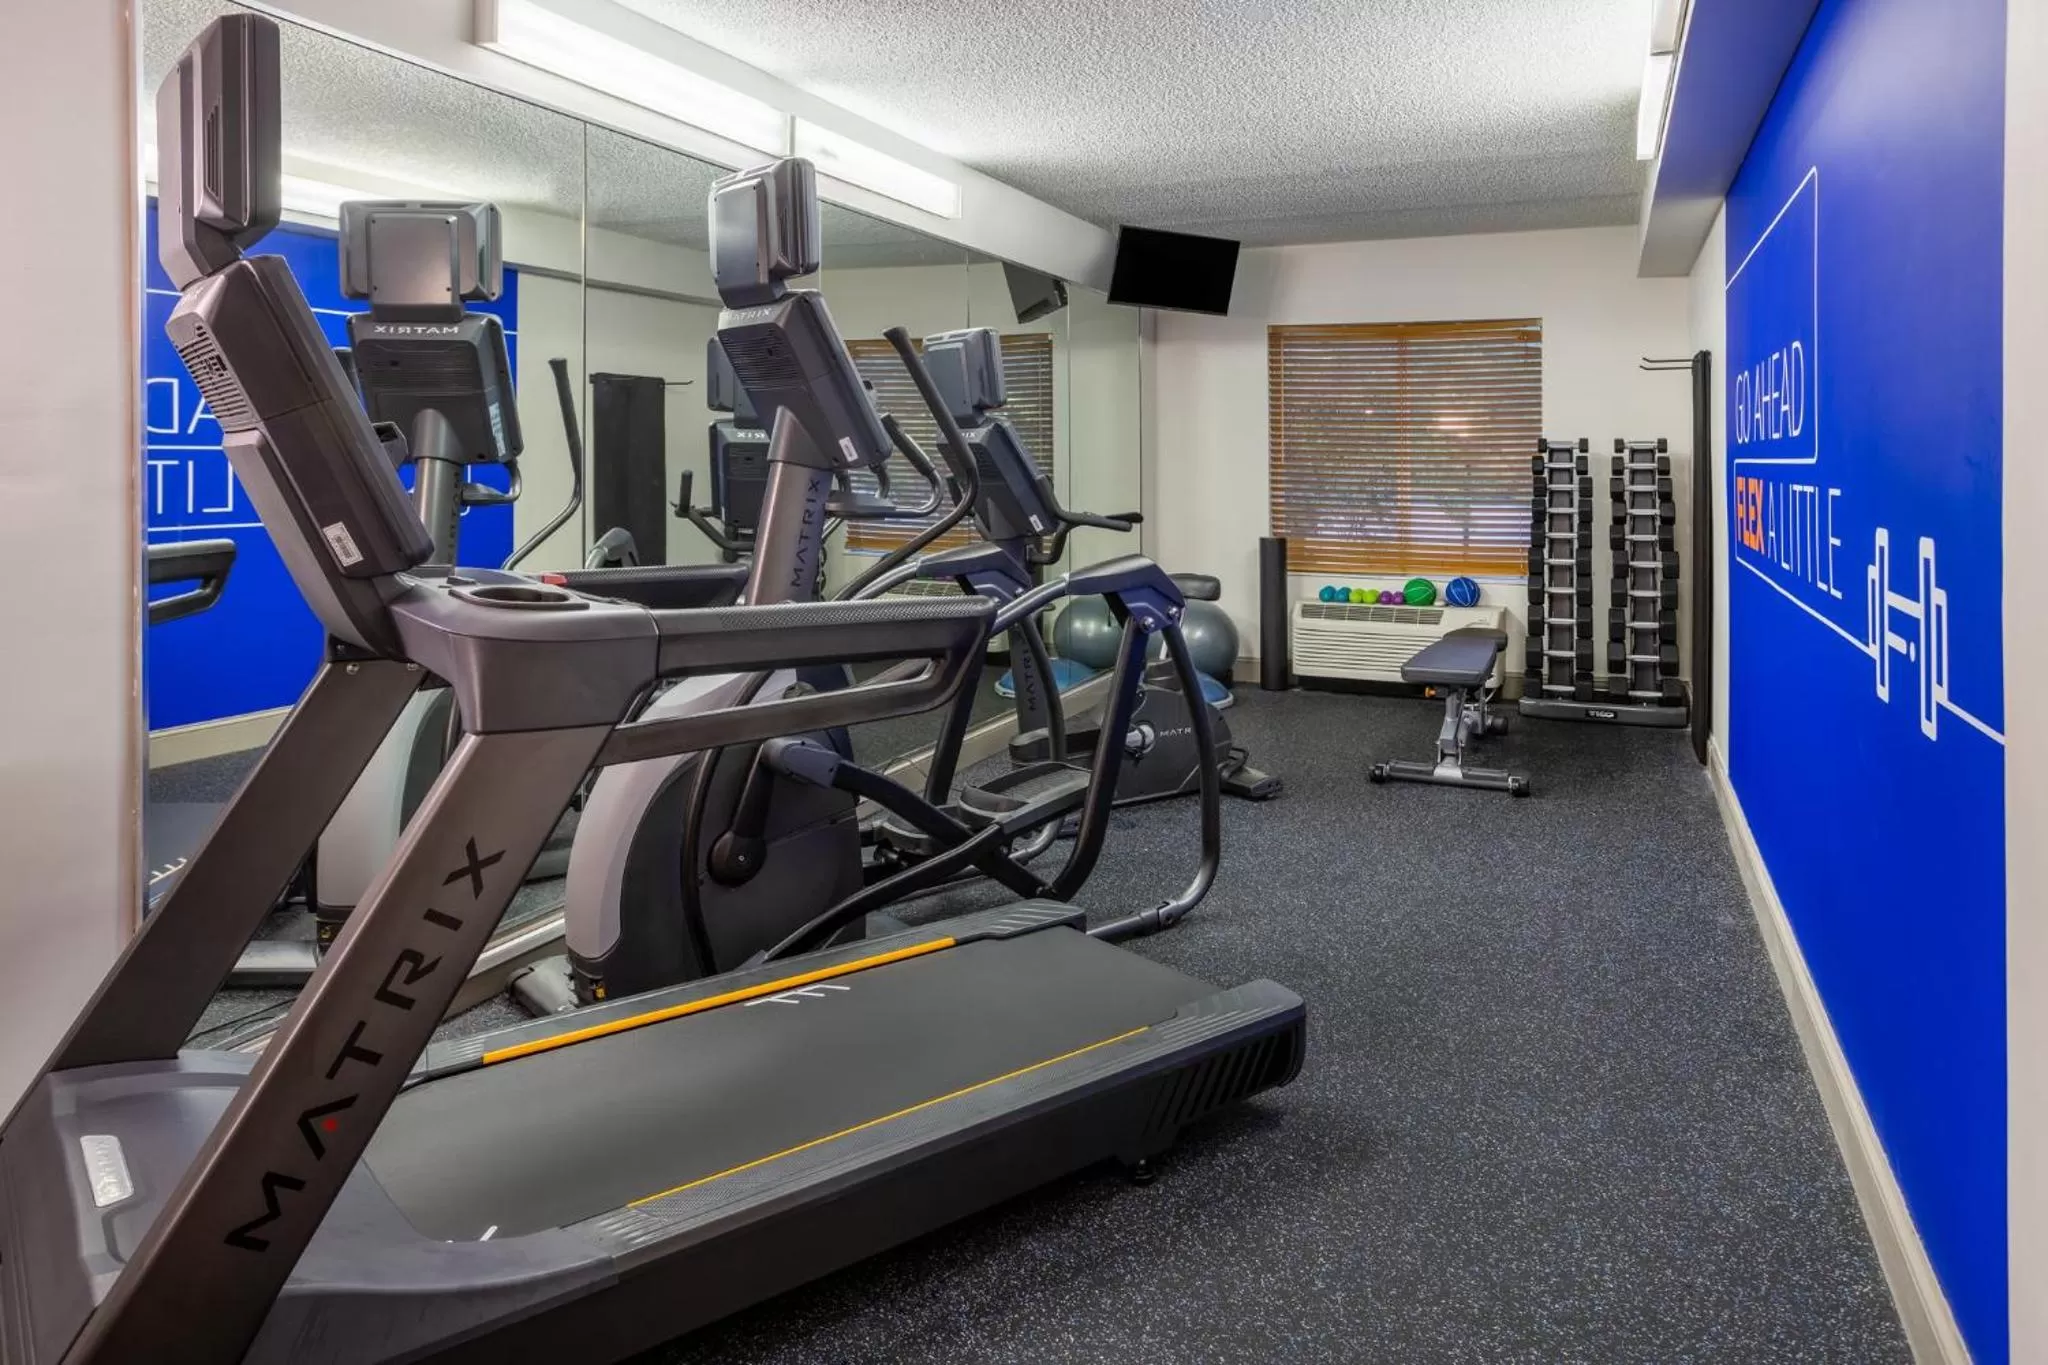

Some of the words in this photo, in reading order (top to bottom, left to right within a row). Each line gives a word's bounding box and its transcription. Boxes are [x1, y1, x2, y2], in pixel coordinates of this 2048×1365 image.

[1735, 370, 1751, 444] GO
[1753, 340, 1805, 442] AHEAD
[790, 479, 821, 588] MATRIX
[1736, 476, 1765, 555] FLEX
[1767, 481, 1778, 563] A
[1780, 482, 1843, 600] LITTLE
[223, 835, 507, 1253] MATRIX
